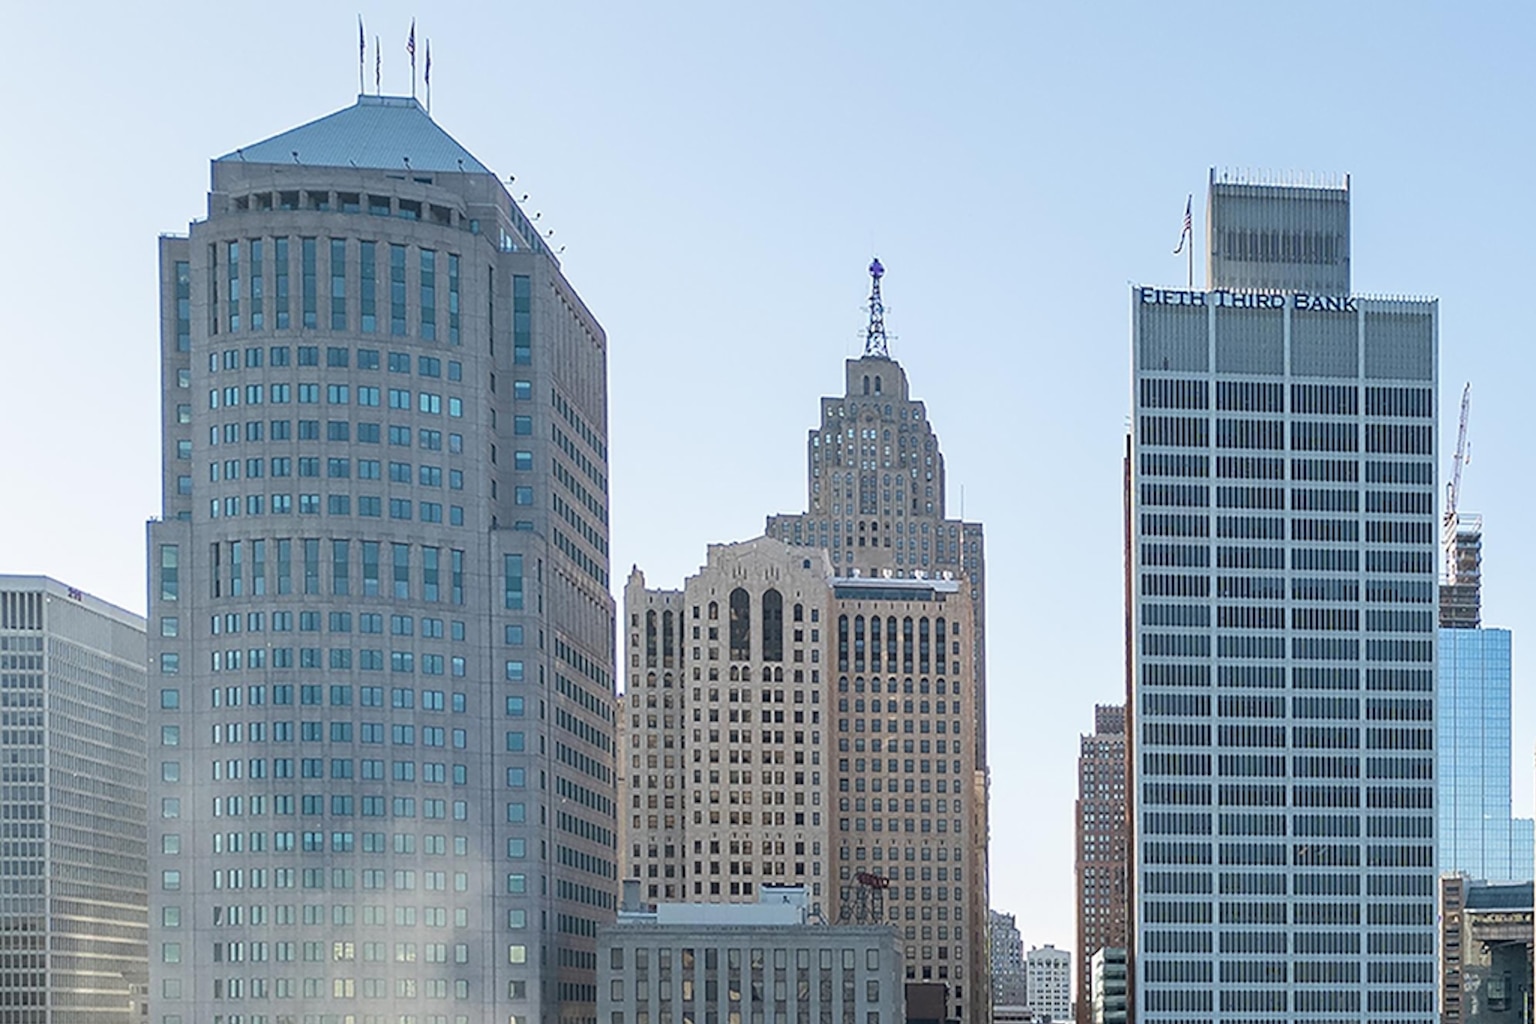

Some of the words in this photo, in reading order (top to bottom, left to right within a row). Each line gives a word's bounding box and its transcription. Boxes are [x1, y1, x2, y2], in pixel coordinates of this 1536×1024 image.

[1140, 287, 1206, 306] FIFTH
[1215, 289, 1286, 309] THIRD
[1294, 292, 1358, 312] BANK
